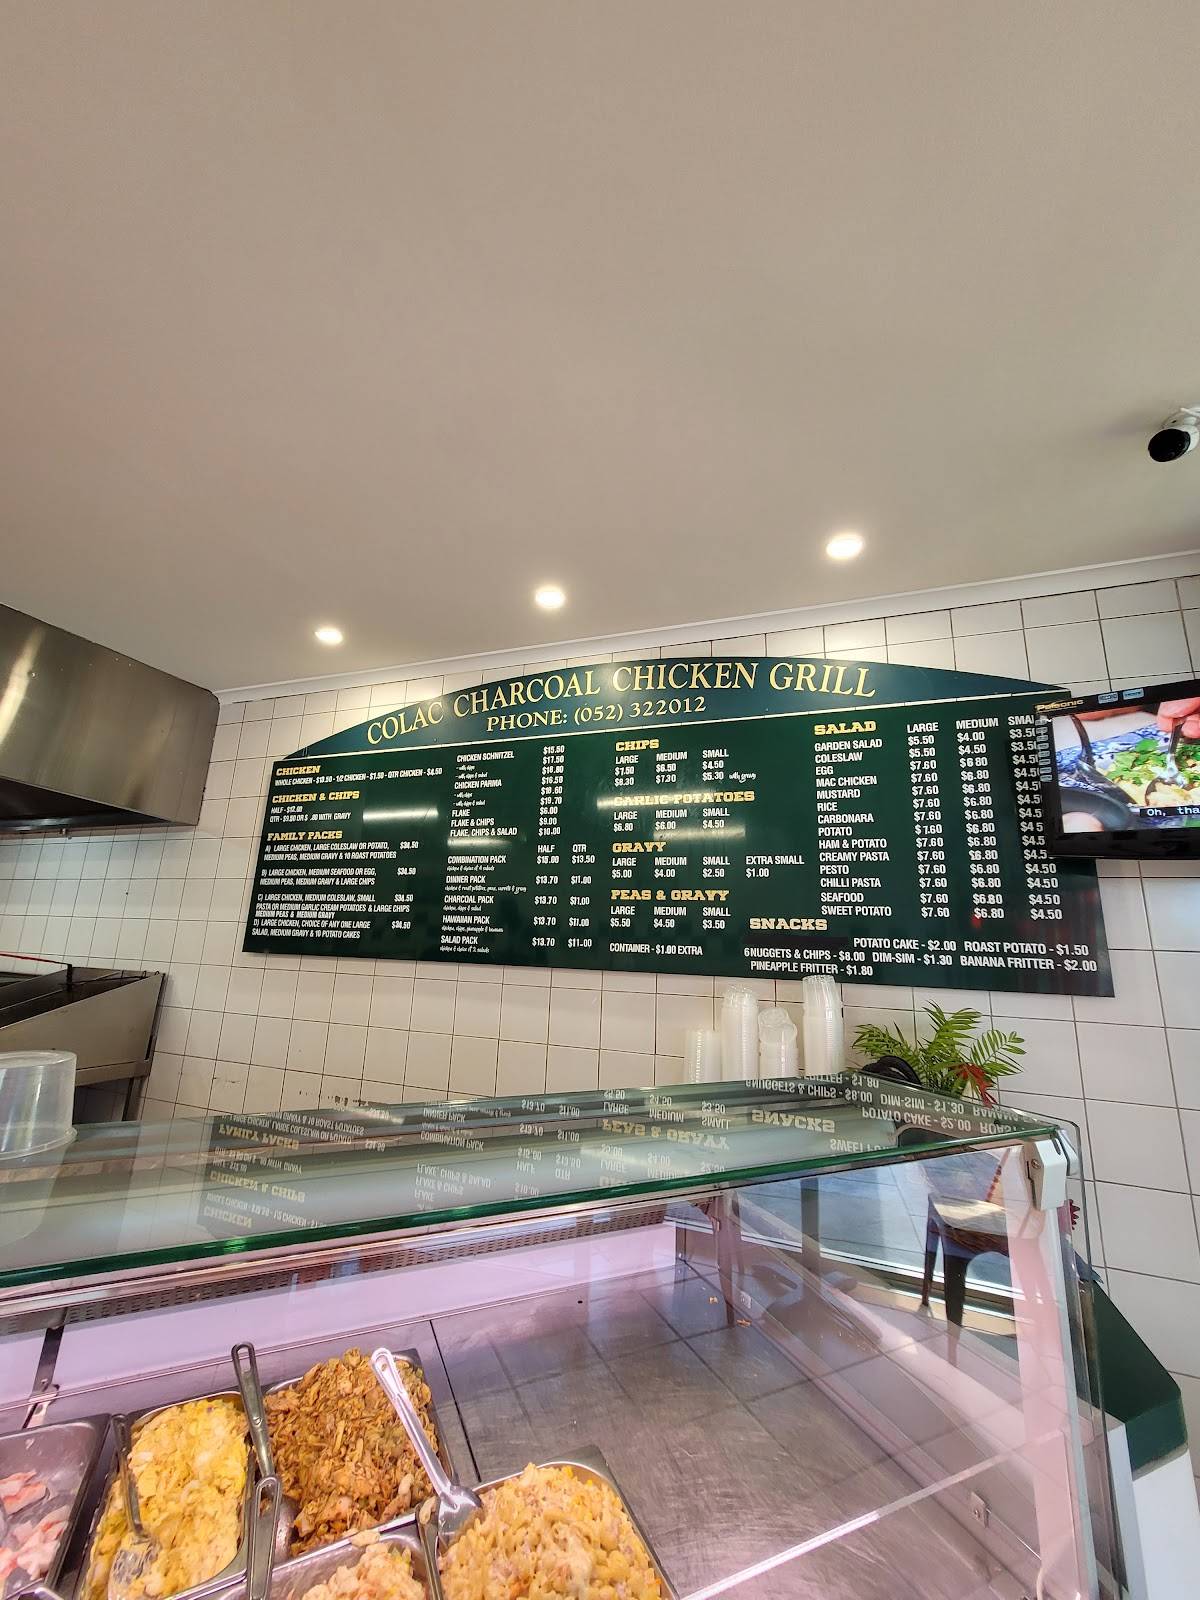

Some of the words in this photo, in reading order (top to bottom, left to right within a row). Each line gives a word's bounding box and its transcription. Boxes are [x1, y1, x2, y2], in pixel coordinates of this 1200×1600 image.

[368, 701, 444, 745] COLAC
[453, 670, 600, 718] CHARCOAL
[613, 662, 758, 692] CHICKEN
[770, 663, 876, 698] GRILL
[487, 709, 567, 732] PHONE:
[574, 704, 623, 725] (052)
[630, 696, 706, 718] 322012
[814, 720, 877, 736] SALAD
[907, 722, 939, 734] LARGE
[956, 718, 999, 730] MEDIUM
[616, 739, 660, 751] CHIPS
[815, 741, 851, 752] GARDEN
[853, 738, 882, 749] SALAD
[908, 735, 935, 747] $5.50
[957, 732, 985, 743] $4.00
[457, 754, 481, 763] CHICKEN
[482, 751, 514, 761] SCHNITZEL
[616, 755, 639, 764] LARGE
[656, 752, 688, 761] MEDIUM
[703, 749, 729, 758] SMALL
[909, 748, 936, 759] $5.50
[958, 744, 987, 755] $4.50
[815, 752, 863, 764] COLESLAW
[276, 765, 321, 776] CHICKEN
[703, 760, 724, 770] $4.50
[703, 772, 724, 781] $5.30
[816, 766, 833, 776] EGG
[816, 778, 836, 788] MAC
[838, 776, 877, 787] CHICKEN
[911, 773, 938, 784] $7.60
[454, 781, 480, 790] CHICKEN
[480, 779, 502, 788] PARMA
[272, 793, 317, 804] CHICKEN
[319, 792, 326, 801] &
[329, 791, 360, 801] CHIPS
[613, 794, 671, 806] GARLIC
[673, 791, 755, 804] POTATOES
[817, 789, 861, 800] MUSTARD
[817, 802, 838, 812] RICE
[913, 798, 940, 809] $7.60
[614, 811, 638, 820] LARGE
[656, 809, 687, 819] MEDIUM
[703, 808, 730, 817] SMALL
[914, 811, 941, 822] $7.60
[965, 810, 994, 820] $6.80
[1147, 808, 1166, 817] Oh,
[476, 818, 495, 826] CHIPS
[539, 817, 557, 826] $9.00
[818, 813, 874, 824] CARBONARA
[703, 820, 724, 829] $4.50
[268, 832, 306, 842] FAMILY
[308, 830, 343, 840] PACKS
[472, 828, 490, 836] CHIPS
[497, 828, 518, 836] SALAD
[818, 827, 852, 837] POTATO
[612, 842, 666, 853] GRAVY
[819, 840, 840, 849] HAM
[842, 839, 849, 849] &
[852, 838, 887, 848] POTATO
[916, 838, 944, 849] $7.60
[968, 836, 996, 847] $6.80
[538, 845, 555, 853] HALF
[573, 844, 587, 853] QTR
[448, 856, 489, 864] COMBINATION
[490, 855, 506, 863] PACK
[572, 855, 595, 864] $13.50
[612, 858, 637, 867] LARGE
[655, 857, 687, 866] MEDIUM
[703, 856, 730, 865] SMALL
[746, 856, 773, 865] EXTRA
[775, 855, 804, 865] SMALL
[820, 852, 858, 862] CREAMY
[860, 852, 889, 861] PASTA
[917, 851, 945, 861] $7.60
[612, 870, 632, 879] $5.00
[654, 869, 676, 878] $4.00
[703, 869, 725, 878] $2.50
[746, 868, 770, 878] $1.00
[820, 865, 849, 875] PESTO
[918, 864, 946, 875] $7.60
[970, 864, 1000, 875] $6.80
[1025, 864, 1057, 875] $4.50
[446, 875, 469, 884] DINNER
[470, 875, 486, 884] PACK
[820, 878, 849, 888] CHILLI
[852, 878, 881, 888] PASTA
[919, 878, 947, 889] $7.60
[1027, 878, 1059, 888] $4.50
[444, 895, 476, 903] CHARCOAL
[478, 896, 494, 904] PACK
[611, 890, 652, 900] PEAS
[656, 890, 666, 900] &
[671, 890, 730, 901] GRAVY
[821, 893, 864, 903] SEAFOOD
[920, 894, 949, 904] $7.60
[1029, 894, 1060, 905] $4.50
[611, 906, 635, 915] LARGE
[654, 907, 687, 916] MEDIUM
[703, 907, 731, 917] SMALL
[822, 906, 853, 916] SWEET
[856, 906, 892, 917] POTATO
[922, 908, 950, 918] $7.60
[974, 908, 1004, 919] $6.80
[1030, 909, 1062, 920] $4.50
[443, 915, 472, 924] HAWAIIAN
[473, 916, 490, 924] PACK
[610, 918, 631, 927] $5.50
[654, 919, 675, 928] $4.50
[703, 920, 725, 930] $3.50
[750, 918, 827, 931] SNACKS
[441, 936, 460, 944] SALAD
[462, 936, 478, 945] PACK
[854, 938, 891, 949] POTATO
[893, 939, 919, 950] CAKE
[928, 940, 957, 952] $2.00
[610, 943, 650, 953] CONTAINER
[678, 946, 703, 956] EXTRA
[964, 941, 1001, 952] ROAST
[1004, 943, 1047, 954] POTATO
[1057, 944, 1089, 956] $1.50
[794, 950, 801, 959] &
[803, 950, 831, 960] CHIPS
[839, 951, 865, 962] $8.00
[873, 952, 915, 964] DIM-SIM
[924, 954, 952, 966] $1.30
[751, 961, 798, 972] PINEAPPLE
[801, 963, 838, 974] FRITTER
[846, 965, 873, 976] $1.80
[960, 956, 1005, 968] BANANA
[1008, 958, 1055, 970] FRITTER
[1064, 960, 1097, 972] $2.00
